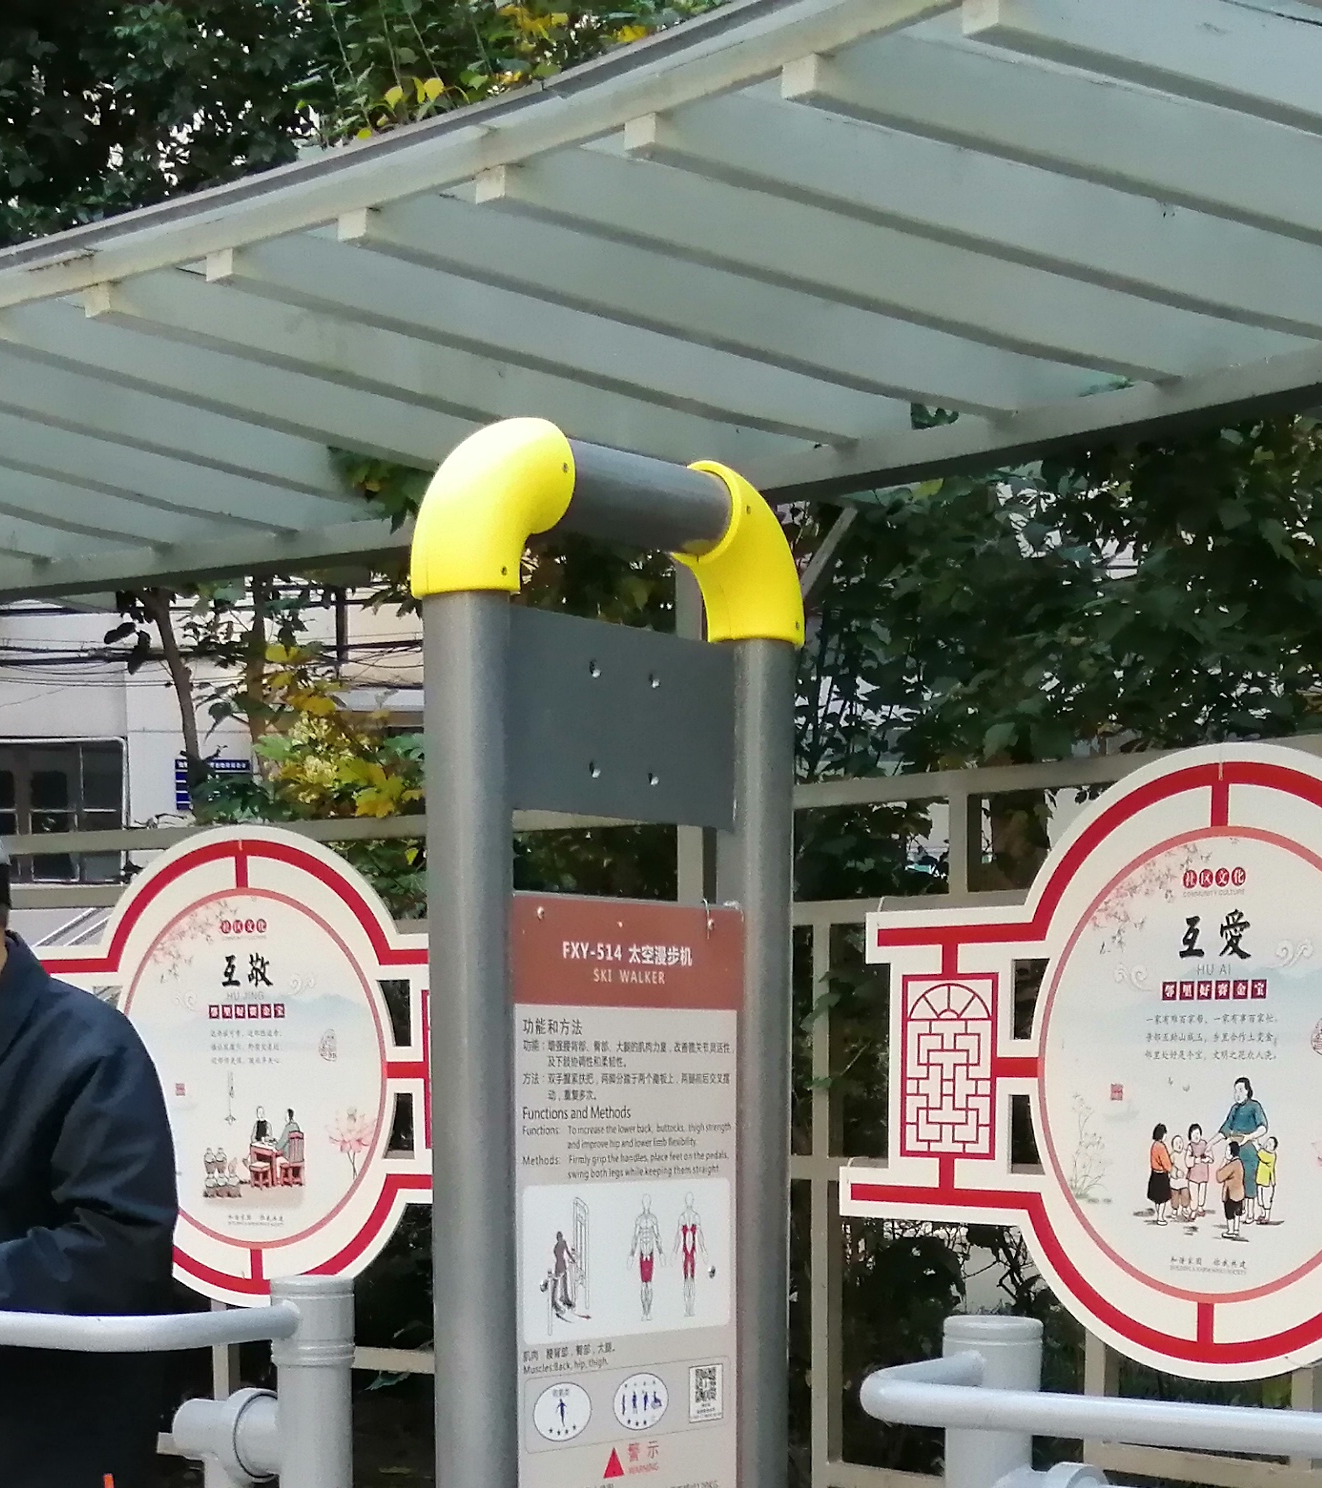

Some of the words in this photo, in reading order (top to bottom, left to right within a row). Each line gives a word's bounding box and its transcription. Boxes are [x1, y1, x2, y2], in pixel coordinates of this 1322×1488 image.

[1183, 867, 1246, 888] 社区文化
[562, 941, 622, 961] FXY-514
[628, 944, 692, 967] 太空漫步机
[222, 953, 273, 987] 互敬
[594, 969, 612, 983] SKI
[619, 970, 665, 985] WALKER
[1197, 964, 1214, 976] HU
[1219, 964, 1231, 975] AI
[227, 992, 239, 1000] HU
[243, 991, 264, 1000] JING
[522, 1017, 582, 1035] 功能和方法
[522, 1106, 568, 1119] Functions
[570, 1106, 588, 1119] and
[590, 1105, 631, 1119] Methods
[567, 1124, 576, 1135] To
[605, 1124, 616, 1133] the
[567, 1139, 580, 1149] and
[607, 1153, 619, 1163] the
[567, 1169, 588, 1181] swing
[590, 1167, 607, 1178] both
